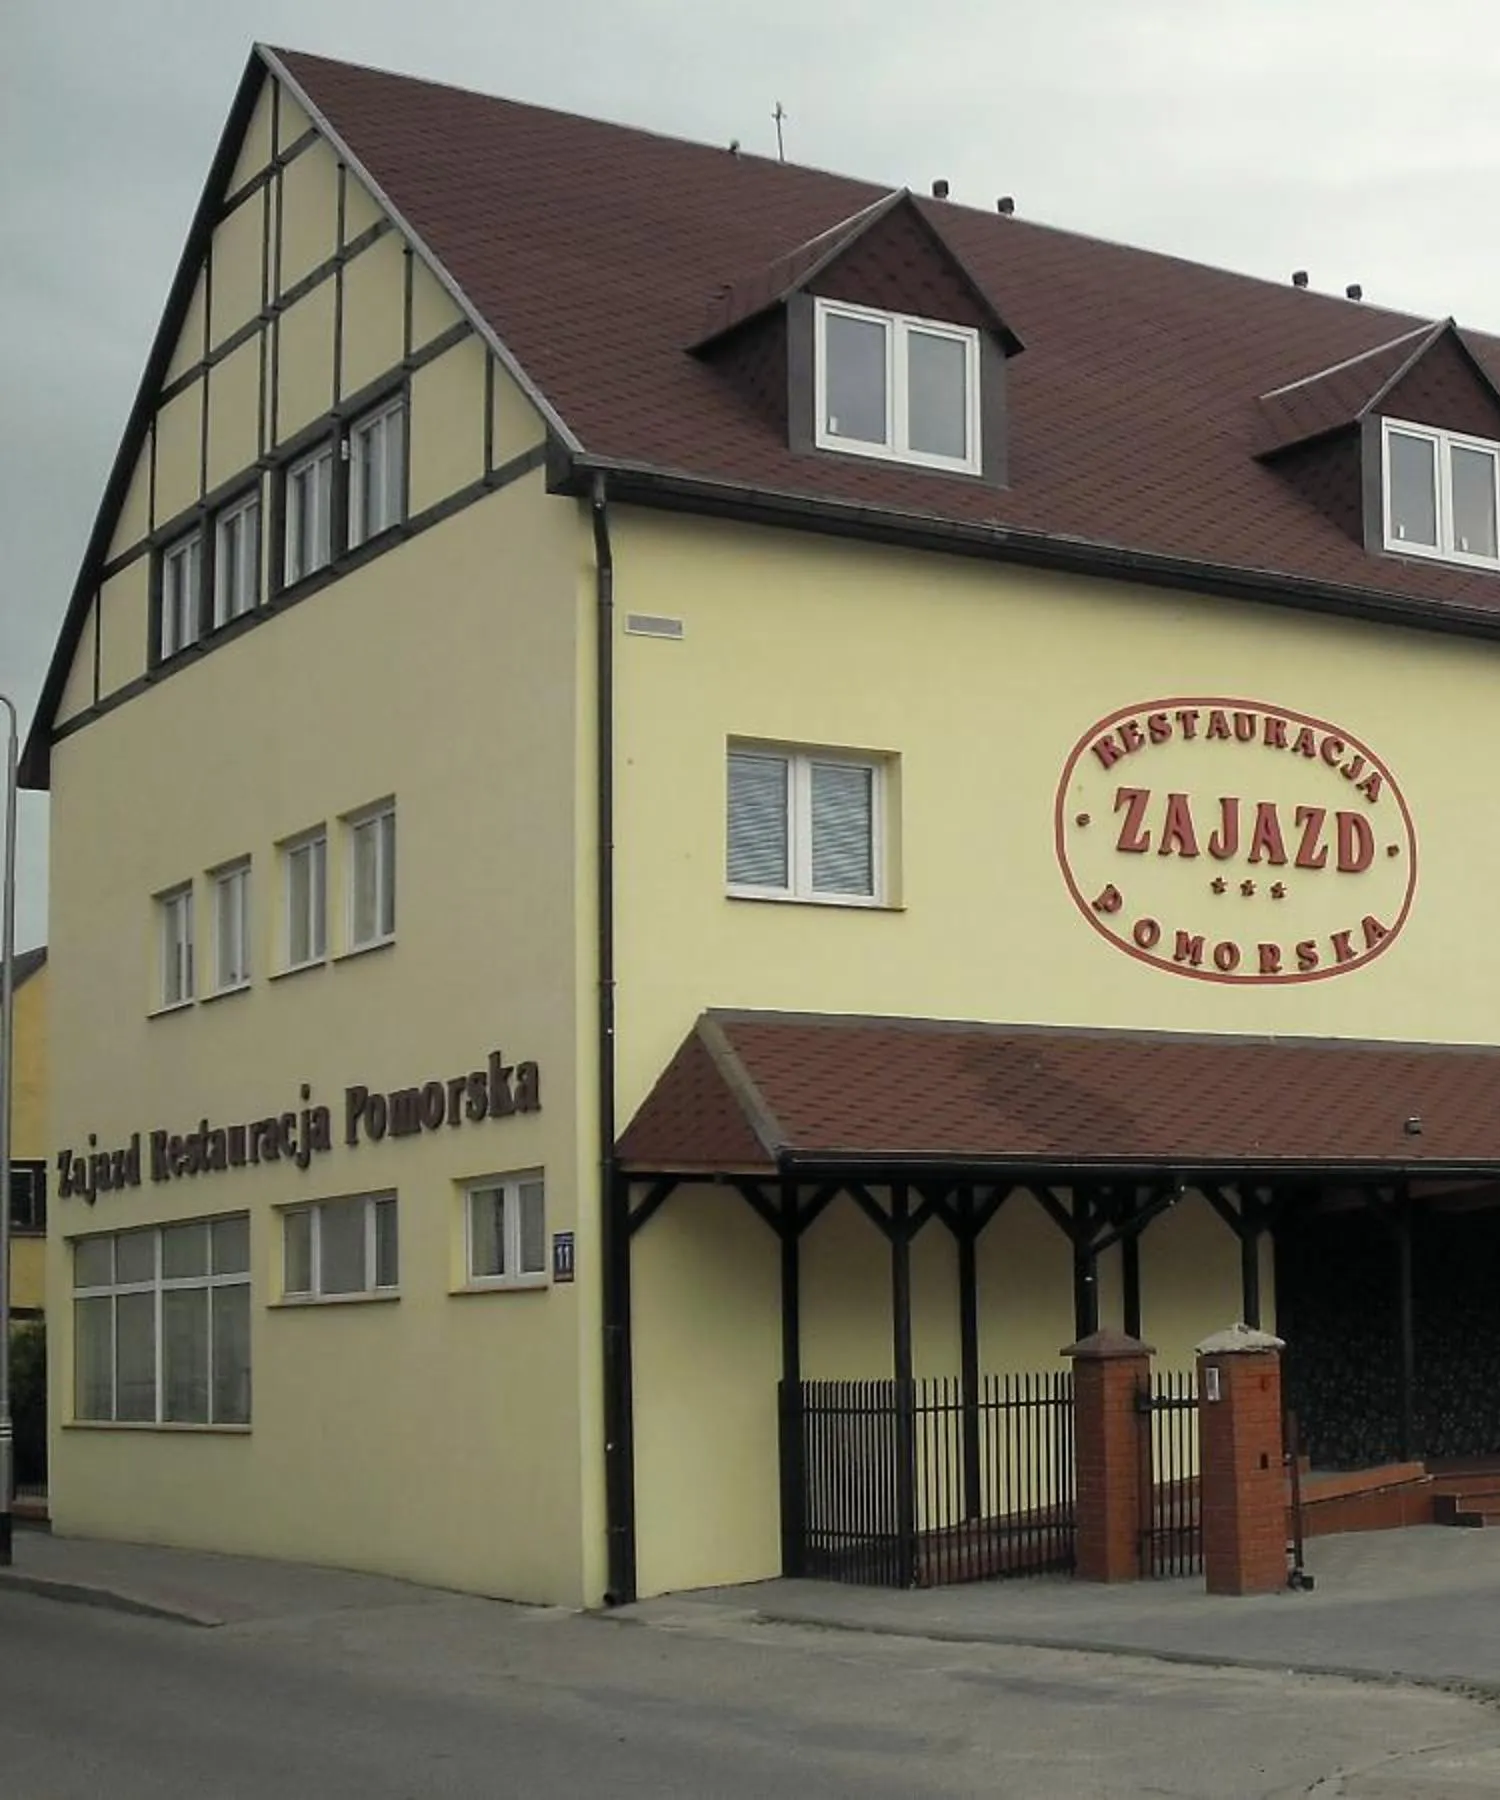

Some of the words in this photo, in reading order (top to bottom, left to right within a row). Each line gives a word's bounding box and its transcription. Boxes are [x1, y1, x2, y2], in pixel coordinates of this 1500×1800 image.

[1091, 709, 1384, 803] RESTAURACJA
[1113, 786, 1376, 872] ZAJAZD
[1091, 883, 1391, 974] POMORSKA
[56, 1133, 142, 1205] Zajazd
[149, 1083, 332, 1181] Restauracja
[344, 1050, 542, 1147] Pomorska
